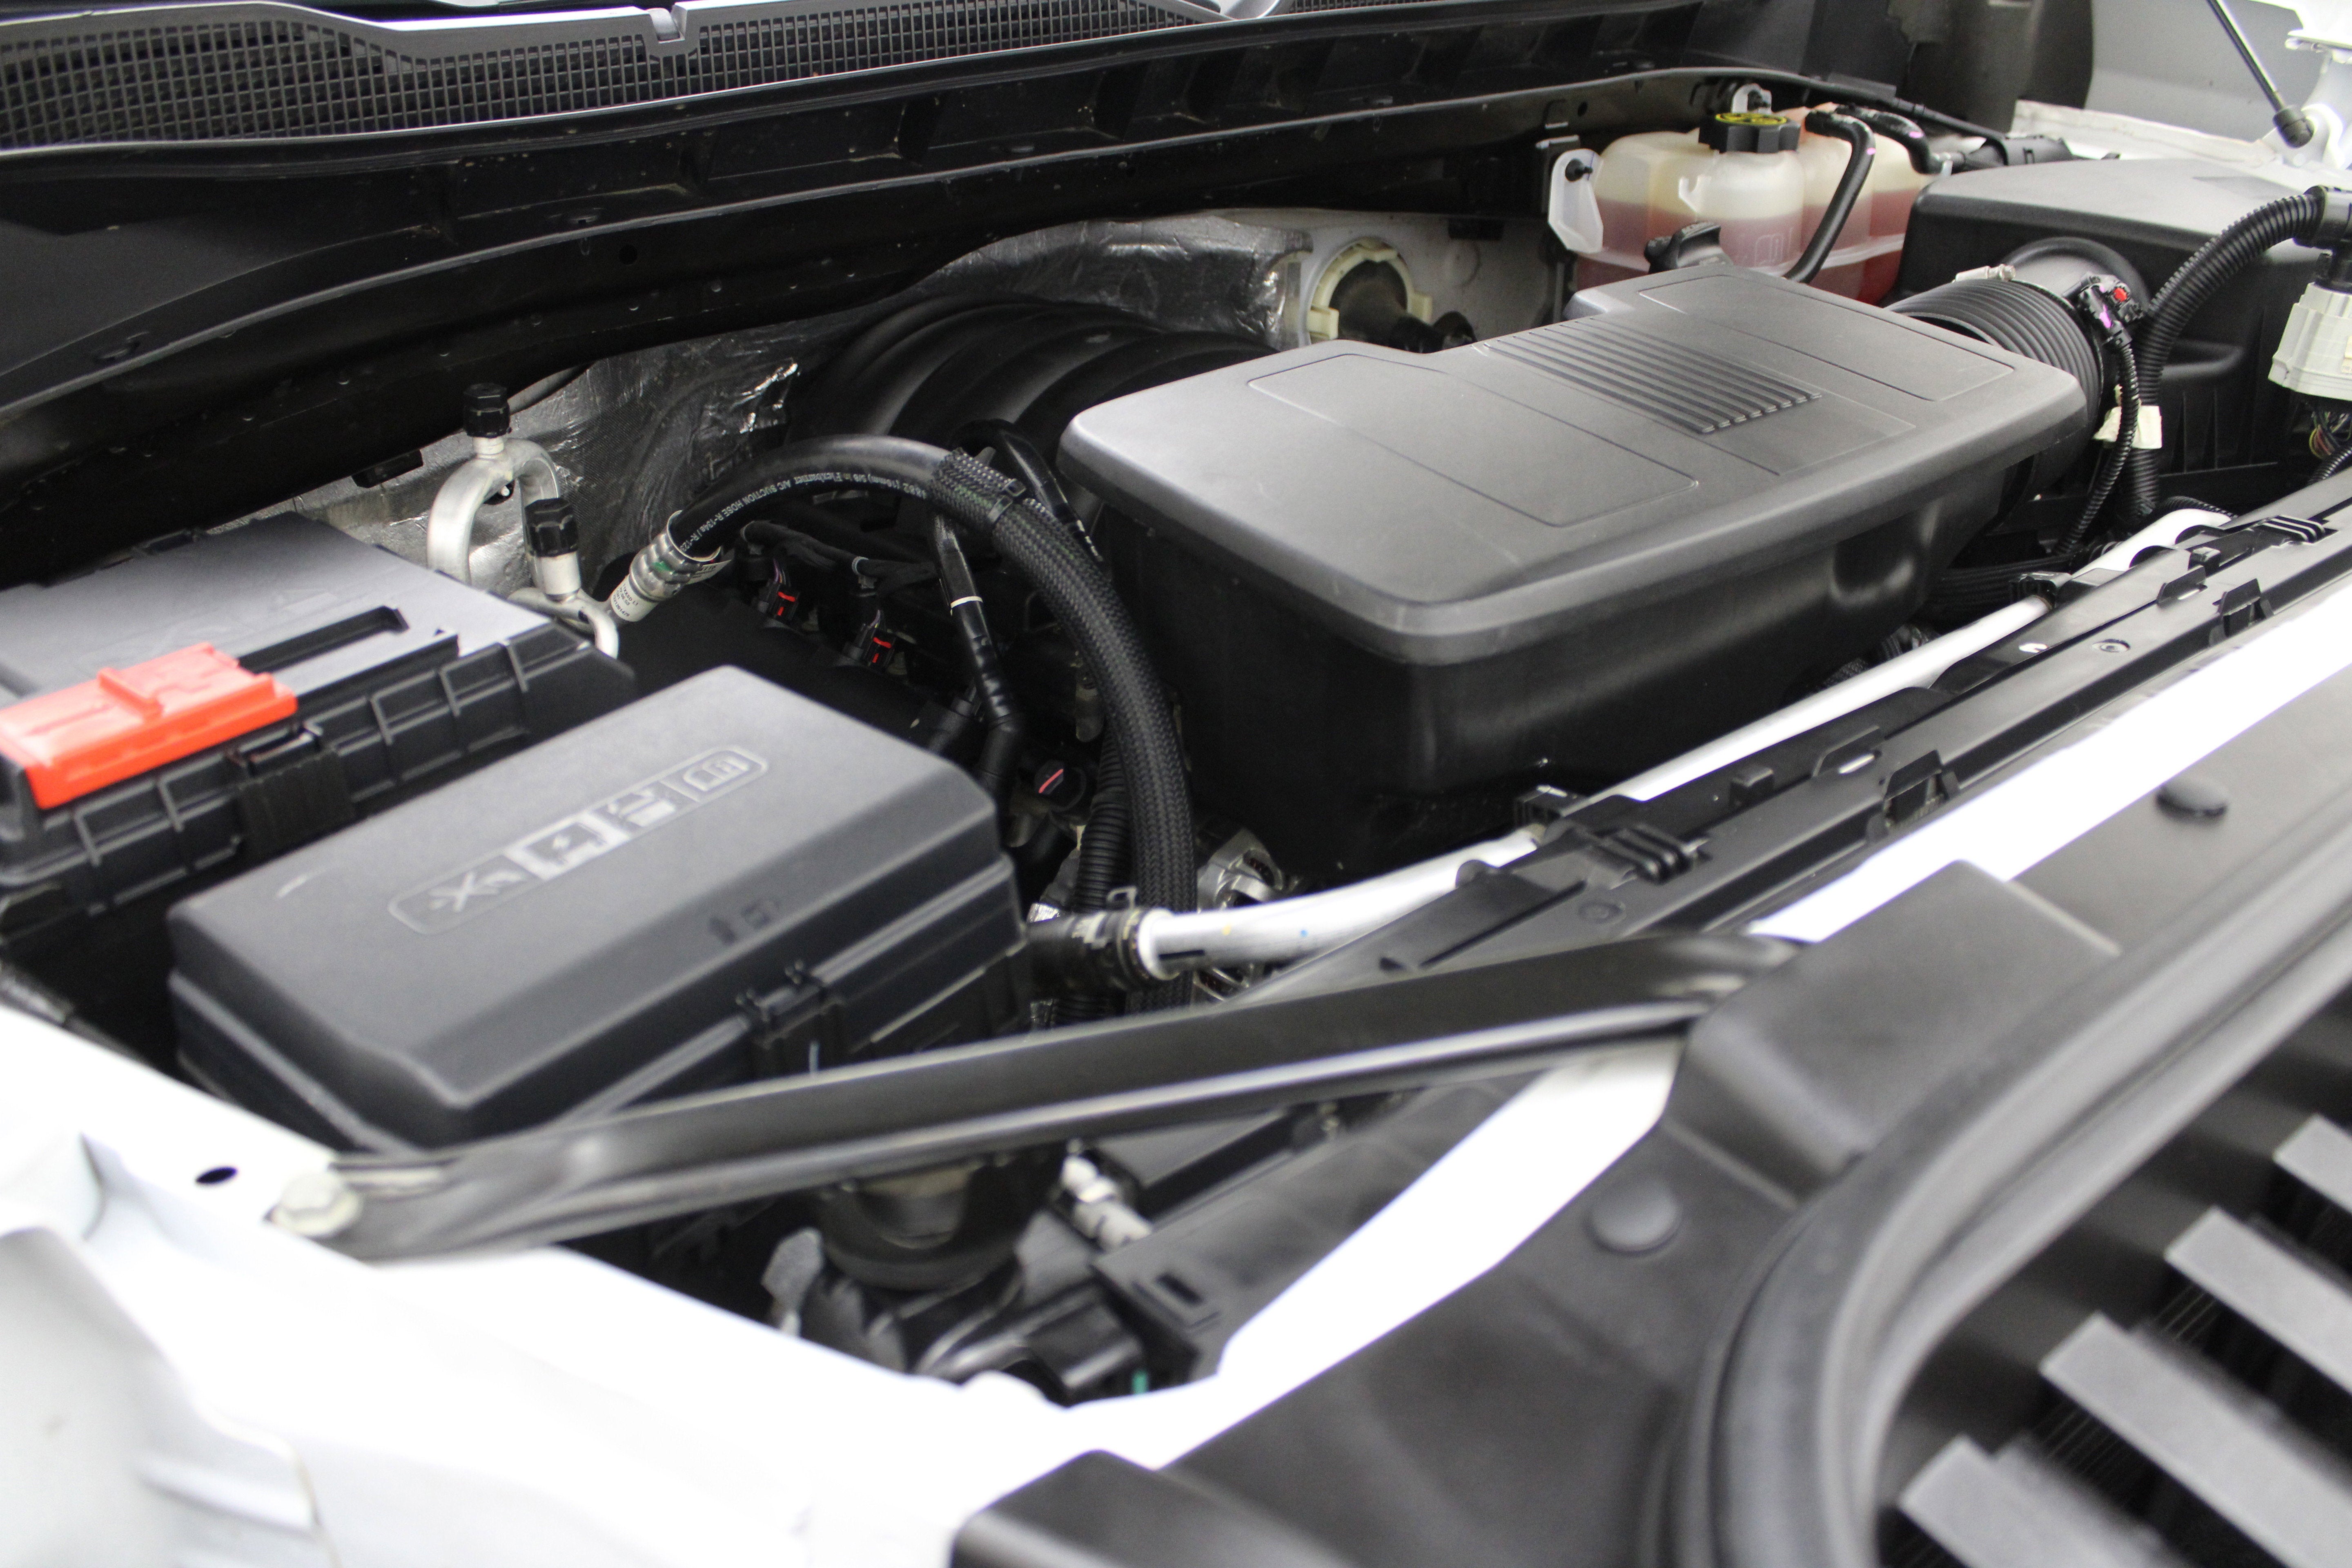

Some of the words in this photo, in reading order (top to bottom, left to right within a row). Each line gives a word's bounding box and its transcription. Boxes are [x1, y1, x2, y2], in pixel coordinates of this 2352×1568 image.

[742, 484, 777, 505] SUCTION
[721, 499, 744, 517] HOSE
[699, 512, 724, 532] R-134a
